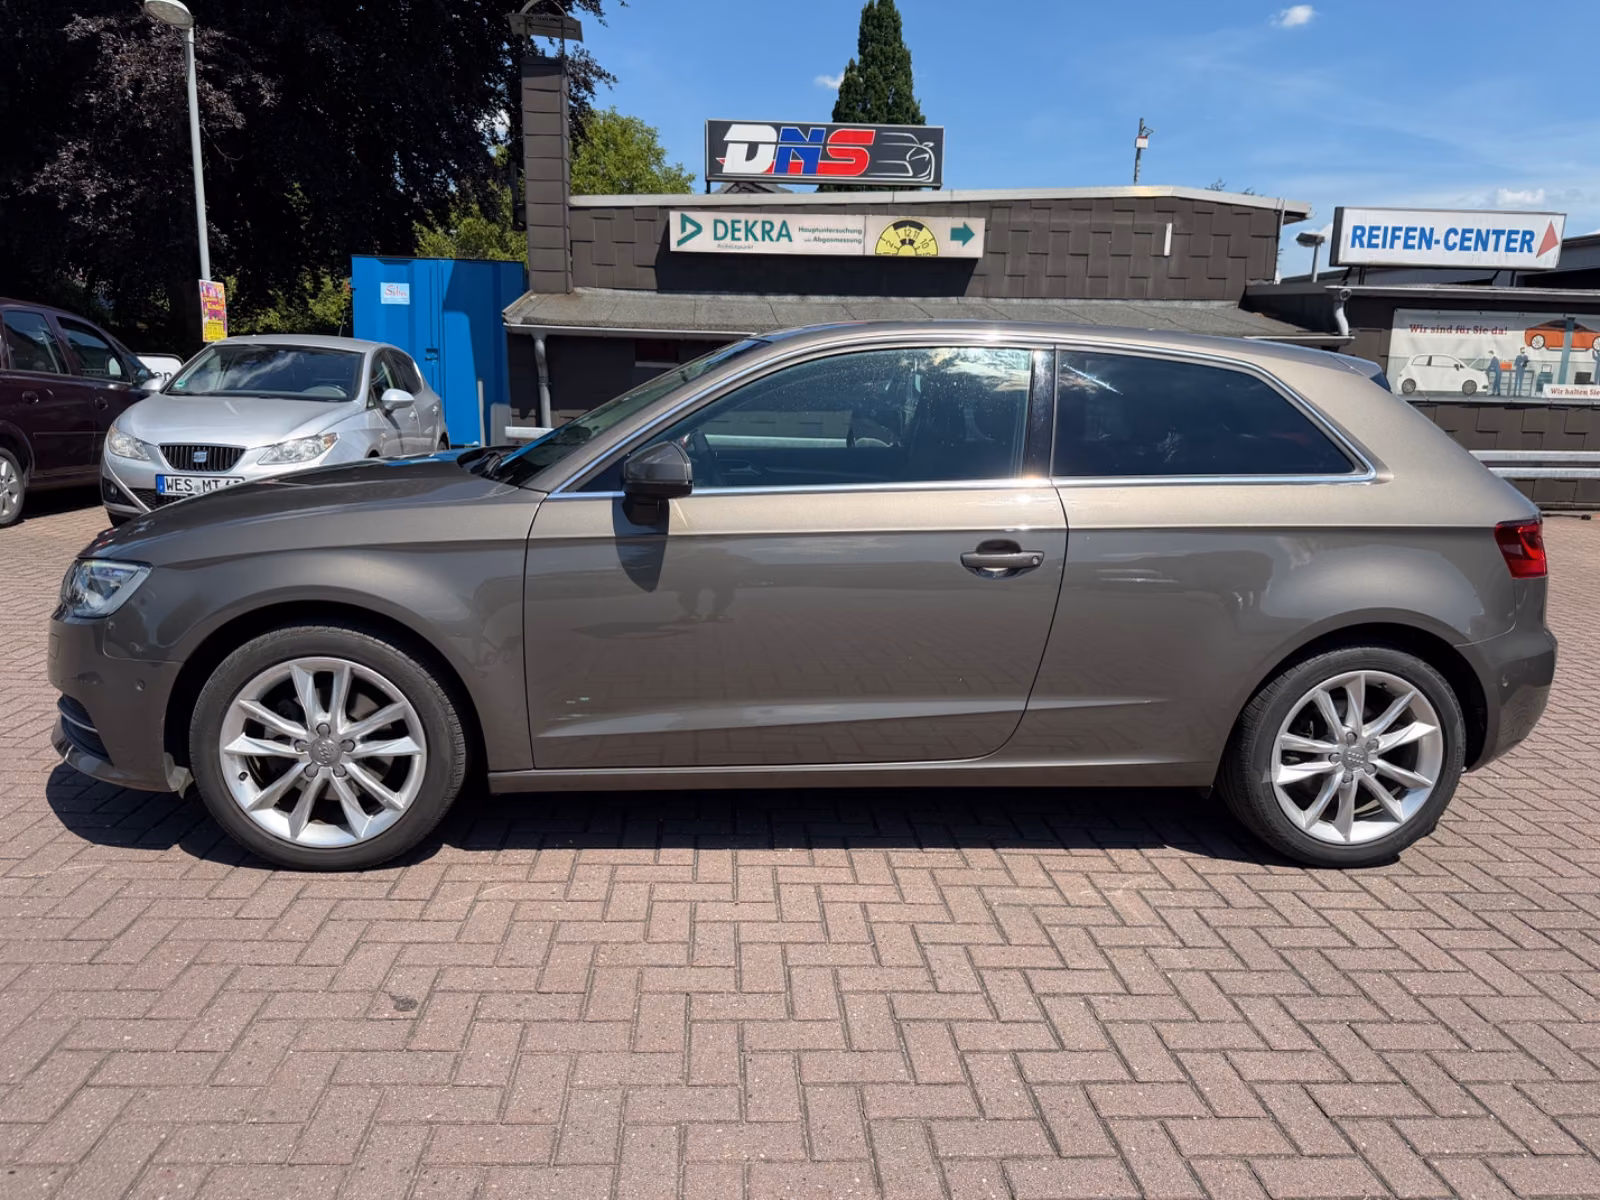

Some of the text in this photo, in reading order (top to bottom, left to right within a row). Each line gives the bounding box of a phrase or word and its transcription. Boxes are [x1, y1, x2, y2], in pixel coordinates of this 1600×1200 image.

[722, 124, 876, 176] DNS
[713, 218, 793, 242] DEKRA
[1350, 224, 1536, 253] REIFEN-CENTER
[1409, 324, 1508, 335] Wir sind für Sie da!
[1551, 387, 1563, 395] Wir
[165, 478, 193, 492] WES
[202, 480, 220, 492] MT
